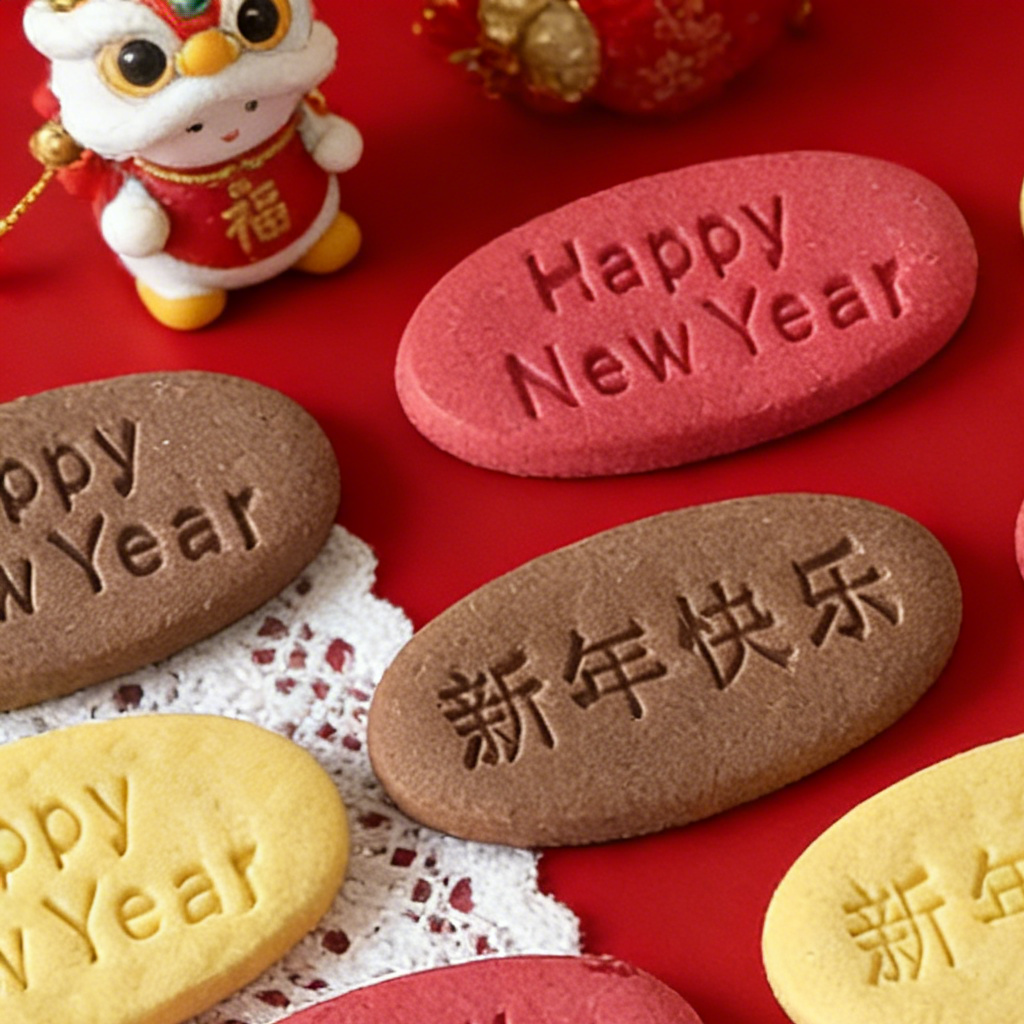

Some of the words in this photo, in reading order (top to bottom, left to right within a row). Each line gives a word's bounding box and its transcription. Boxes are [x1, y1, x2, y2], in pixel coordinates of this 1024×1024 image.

[226, 178, 292, 261] 福
[525, 195, 788, 314] Happy
[505, 322, 693, 420] New
[704, 256, 904, 357] Year
[47, 487, 258, 594] Year
[437, 536, 904, 771] 新年快乐
[40, 842, 257, 964] Year
